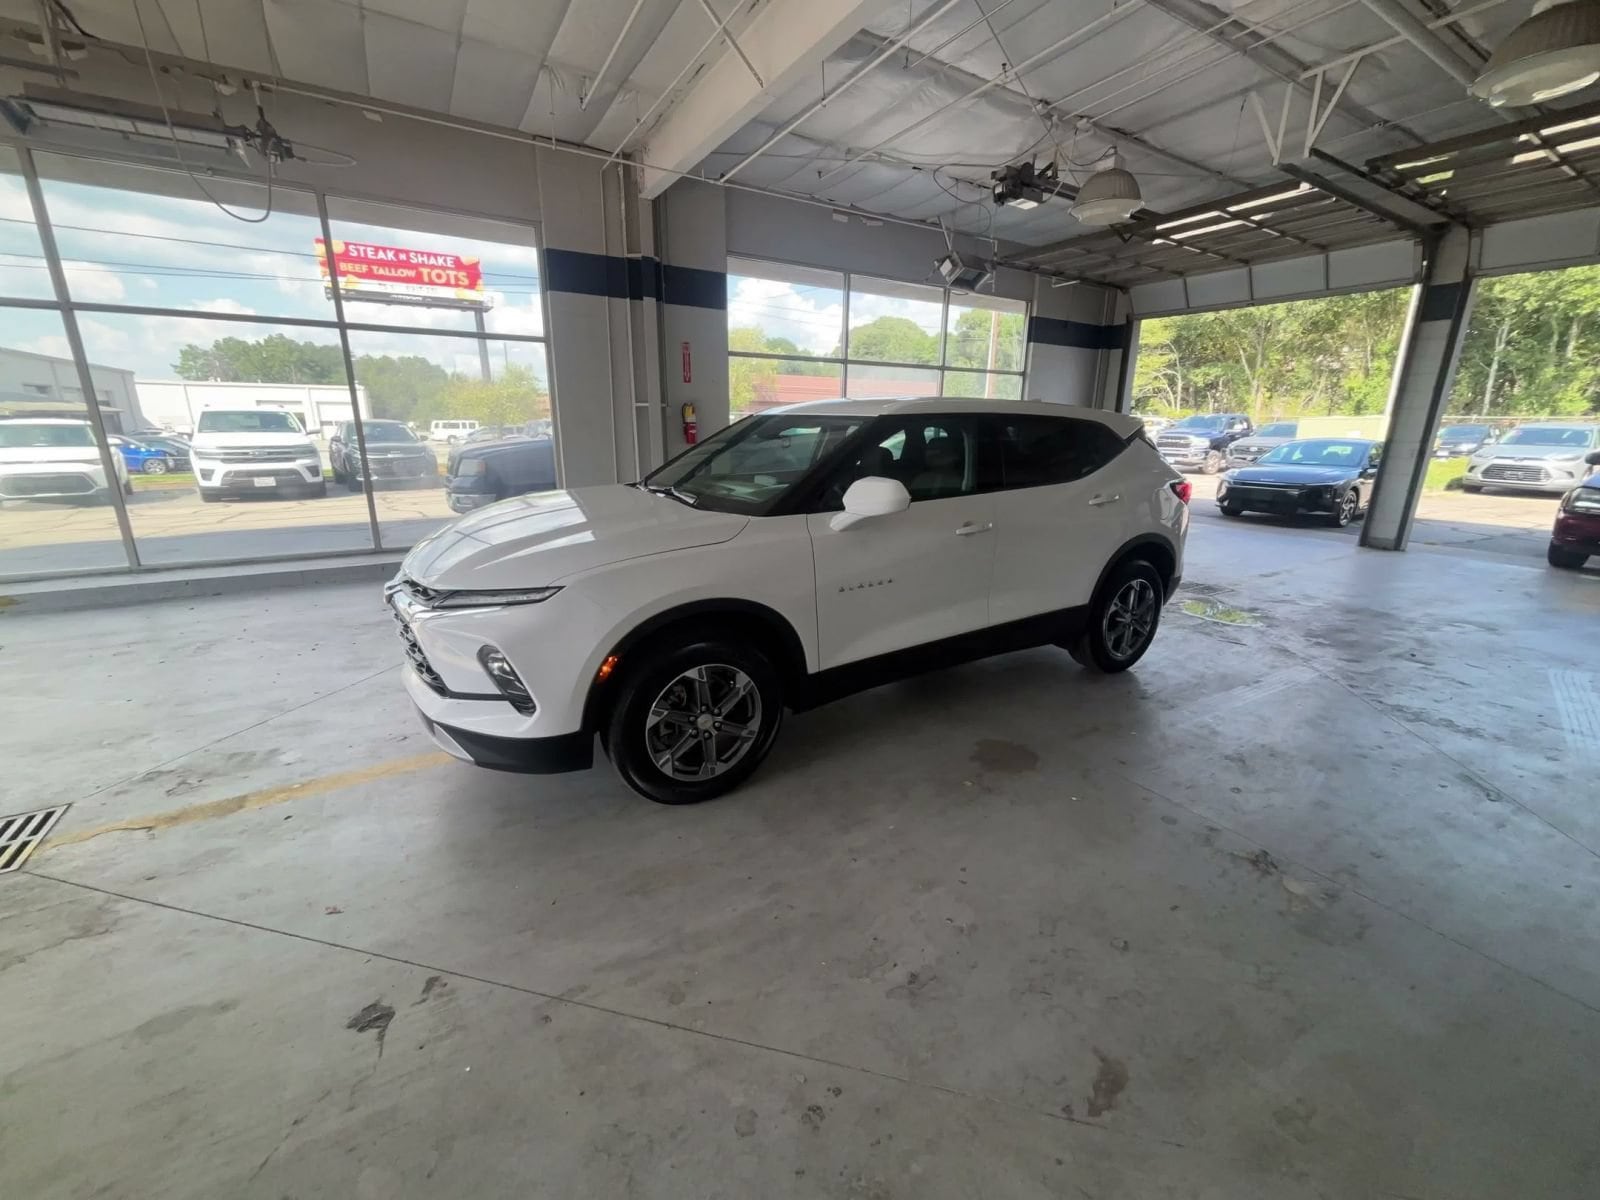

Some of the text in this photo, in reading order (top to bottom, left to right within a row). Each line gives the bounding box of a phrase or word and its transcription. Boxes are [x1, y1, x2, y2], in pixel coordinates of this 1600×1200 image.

[348, 244, 396, 261] STEAK
[409, 253, 455, 267] SHAKE
[339, 262, 469, 286] BEEF TALLOW TOTS
